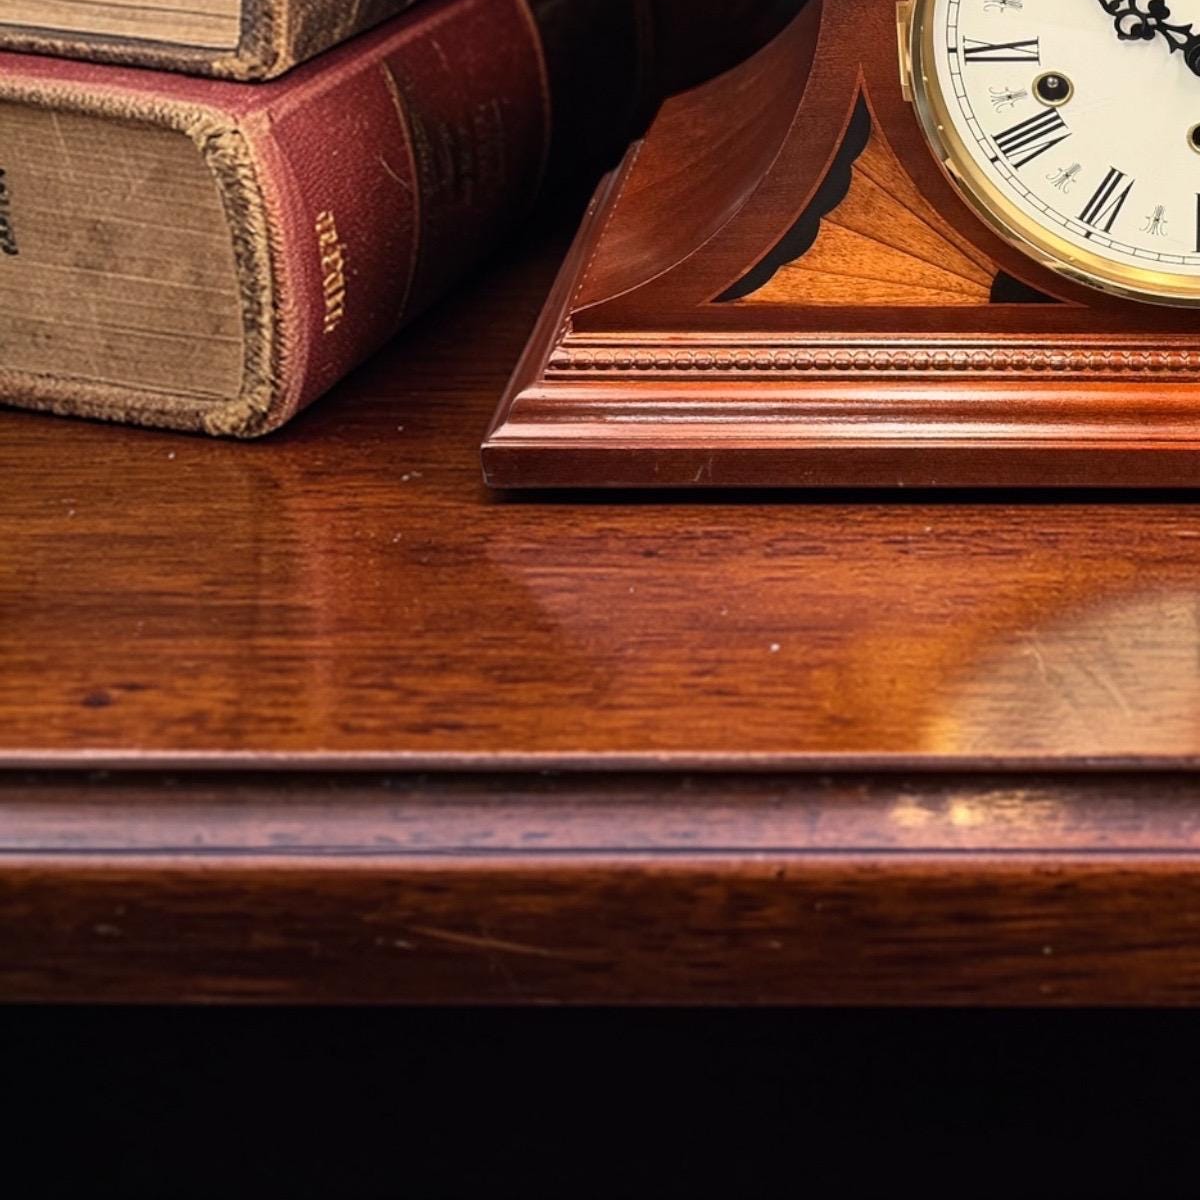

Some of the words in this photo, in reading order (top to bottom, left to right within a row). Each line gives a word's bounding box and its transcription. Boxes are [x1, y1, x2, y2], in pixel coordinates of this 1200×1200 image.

[963, 35, 1041, 66] IX
[991, 107, 1072, 171] VIII
[1075, 166, 1135, 234] VII
